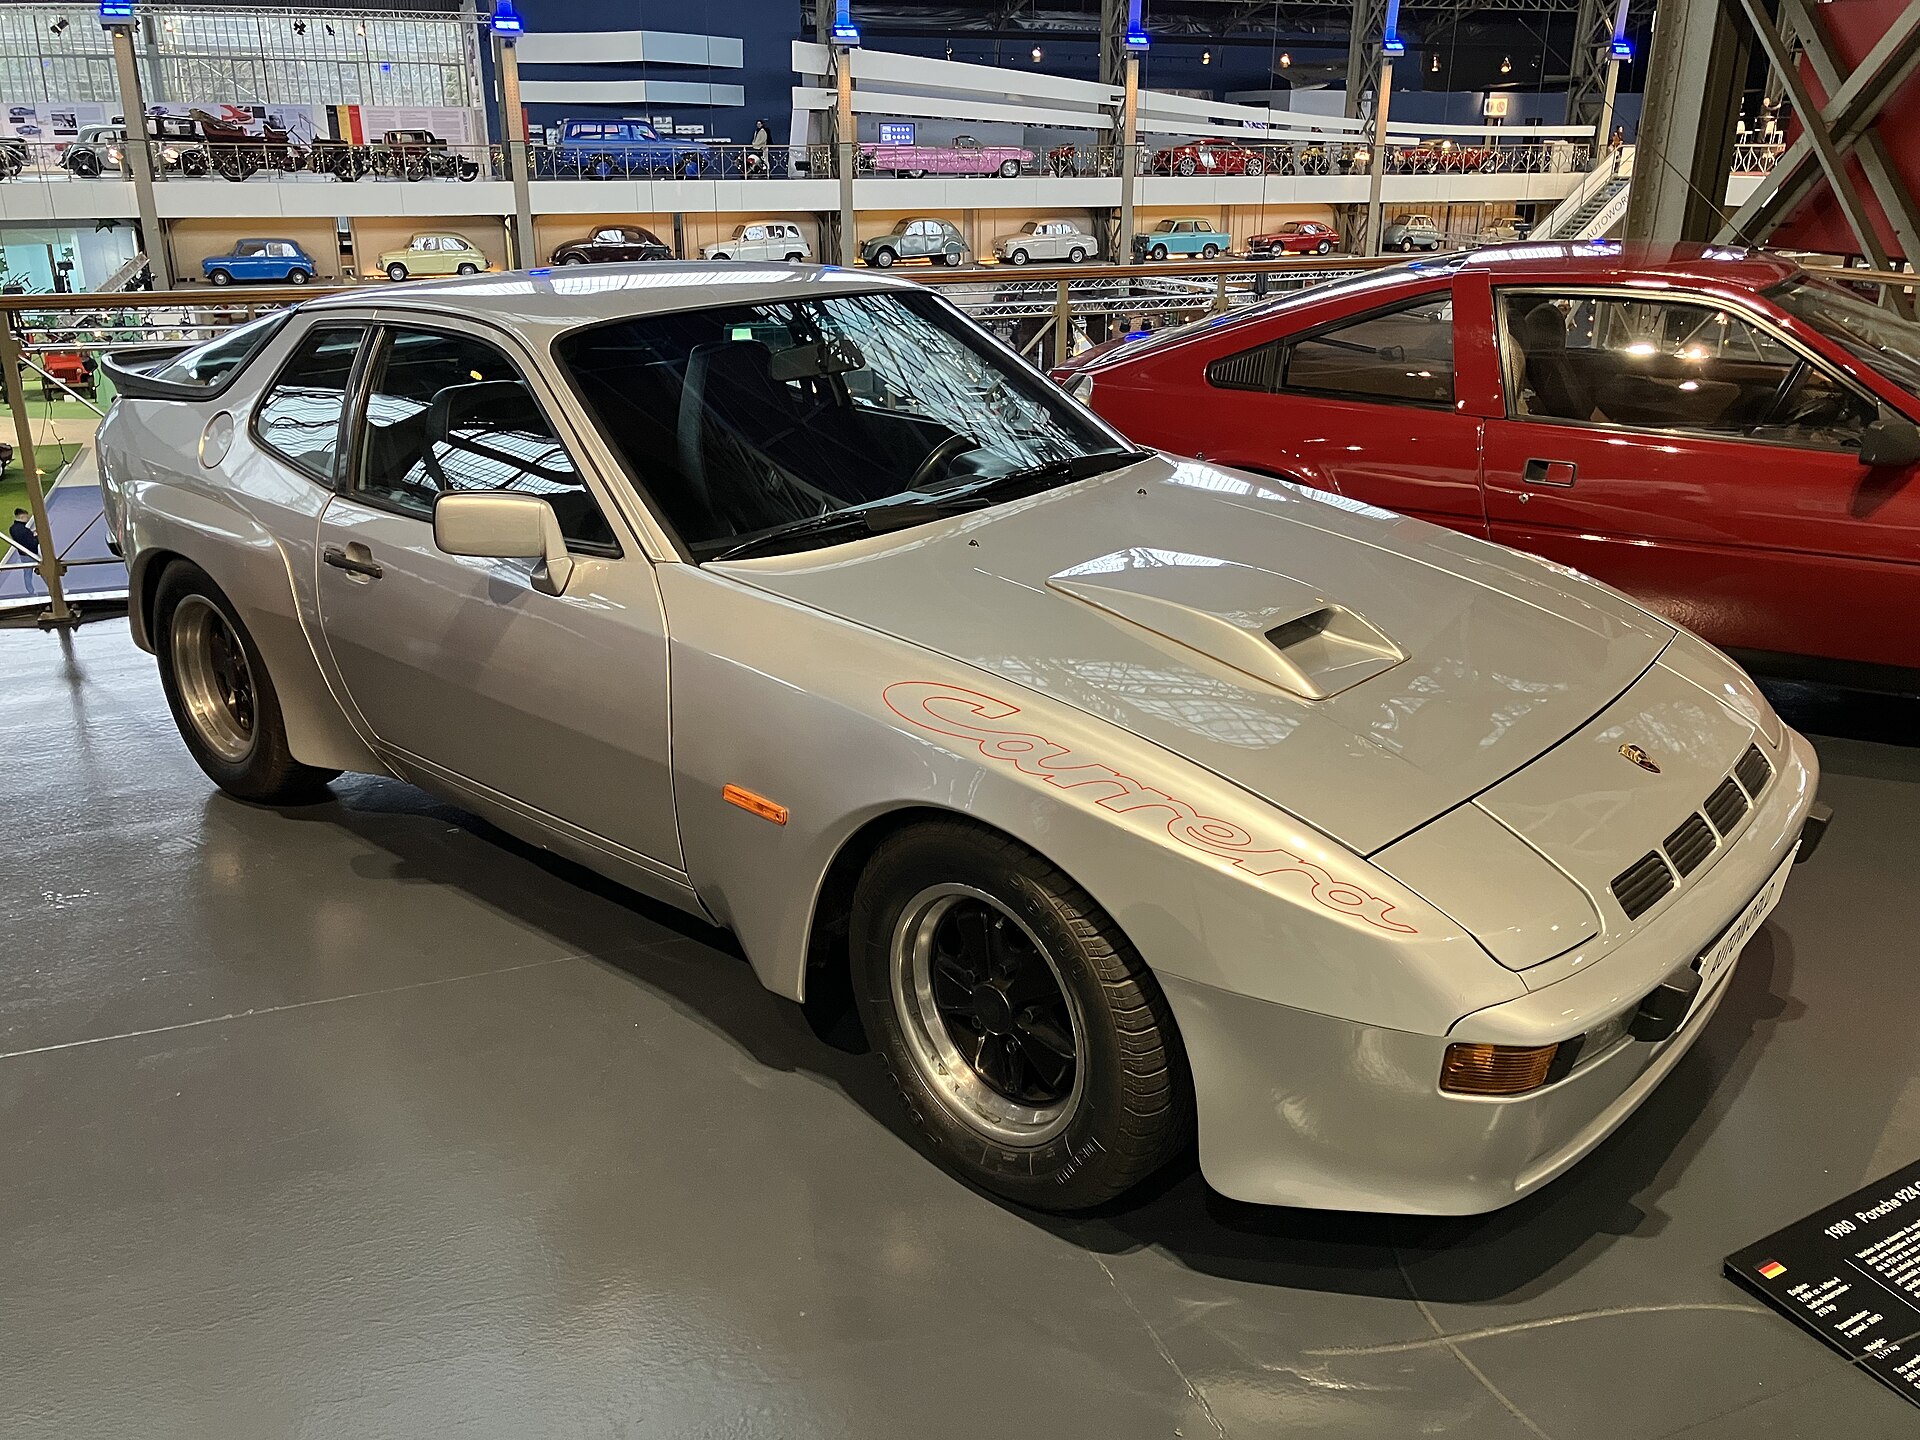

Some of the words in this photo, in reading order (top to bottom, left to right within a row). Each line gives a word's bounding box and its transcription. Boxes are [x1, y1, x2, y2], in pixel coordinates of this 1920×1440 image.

[882, 681, 1418, 933] Carrera
[1824, 1220, 1857, 1240] 1980
[1855, 1199, 1902, 1224] Porsche
[1895, 1186, 1920, 1203] 924
